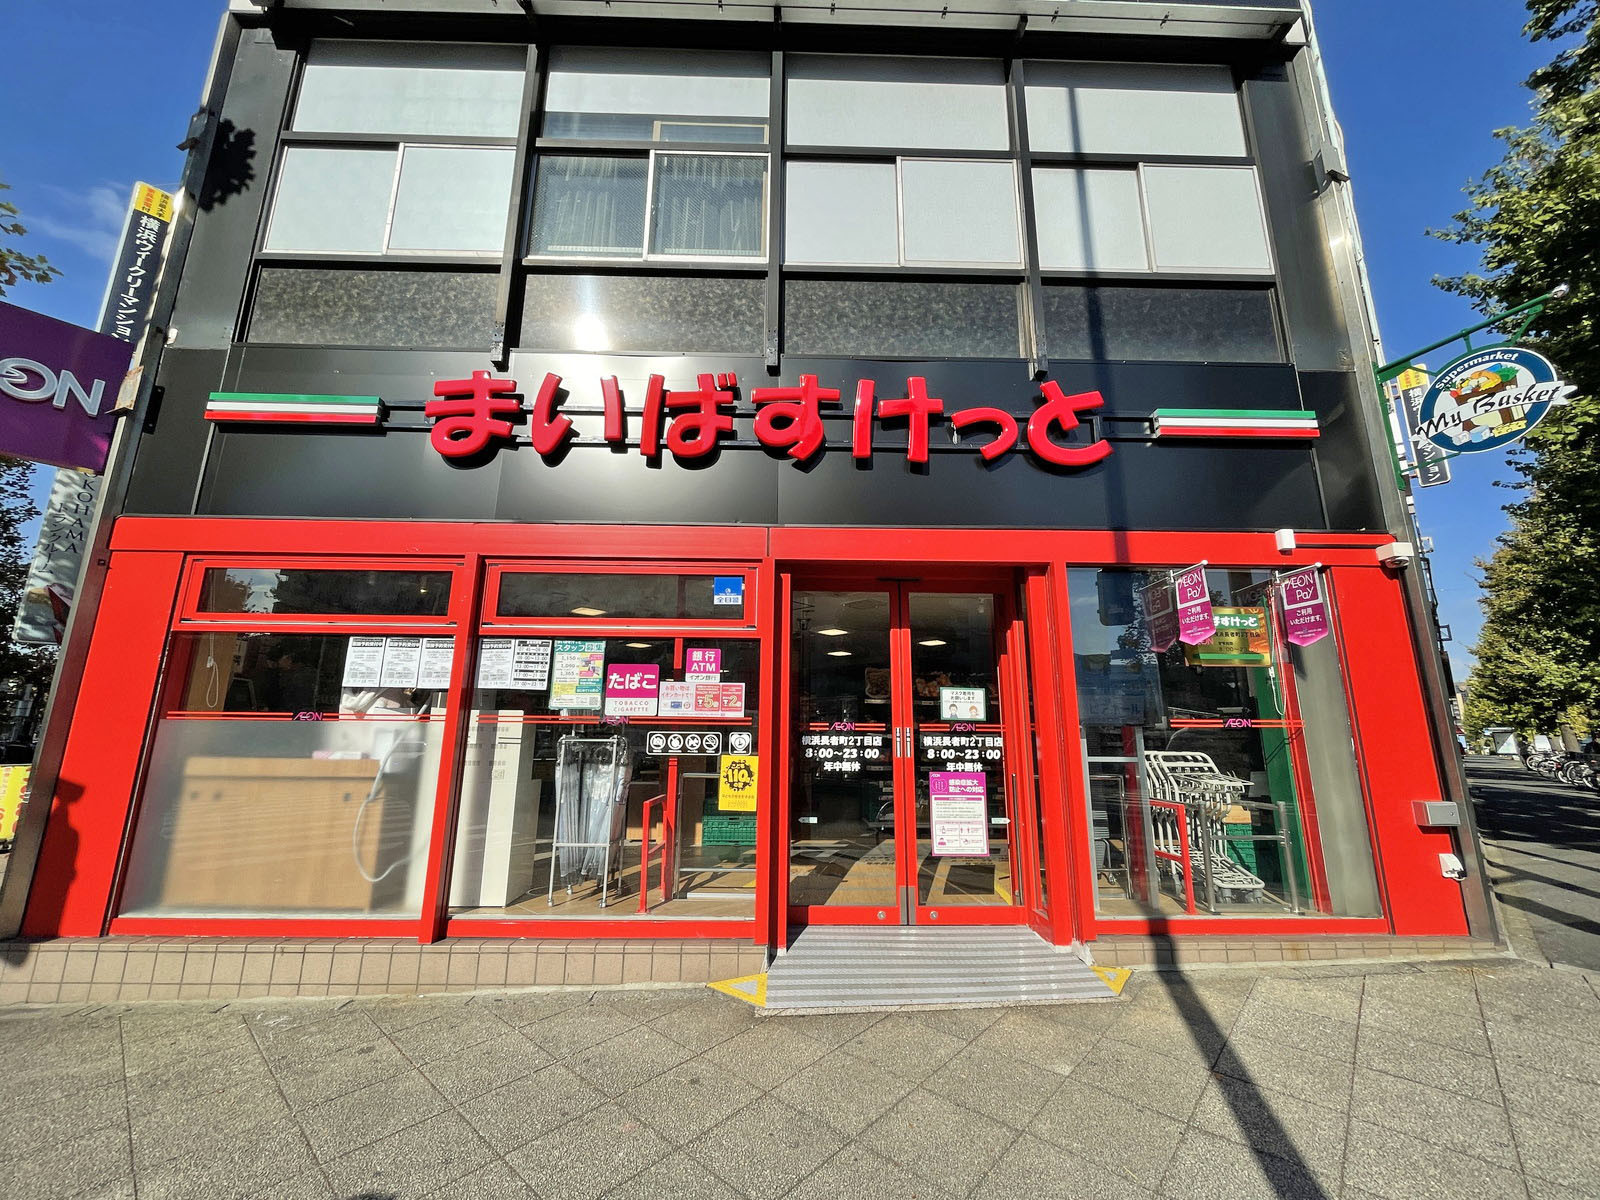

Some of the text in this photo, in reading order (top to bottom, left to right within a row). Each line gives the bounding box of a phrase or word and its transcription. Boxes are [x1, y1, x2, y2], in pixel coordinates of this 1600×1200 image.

[111, 215, 161, 343] 横浜ウィークリーマンショ
[1435, 351, 1519, 390] Supermarket
[1416, 383, 1561, 439] My Basket
[425, 370, 1113, 467] まいばすけっと
[692, 650, 715, 662] 銀行
[691, 662, 716, 672] ATM
[608, 672, 657, 690] たばこ
[801, 735, 883, 747] 横浜長者町2丁目店
[923, 735, 1004, 747] 横浜長者町2丁目店
[823, 761, 861, 772] 年中無休
[946, 761, 983, 772] 年中無休
